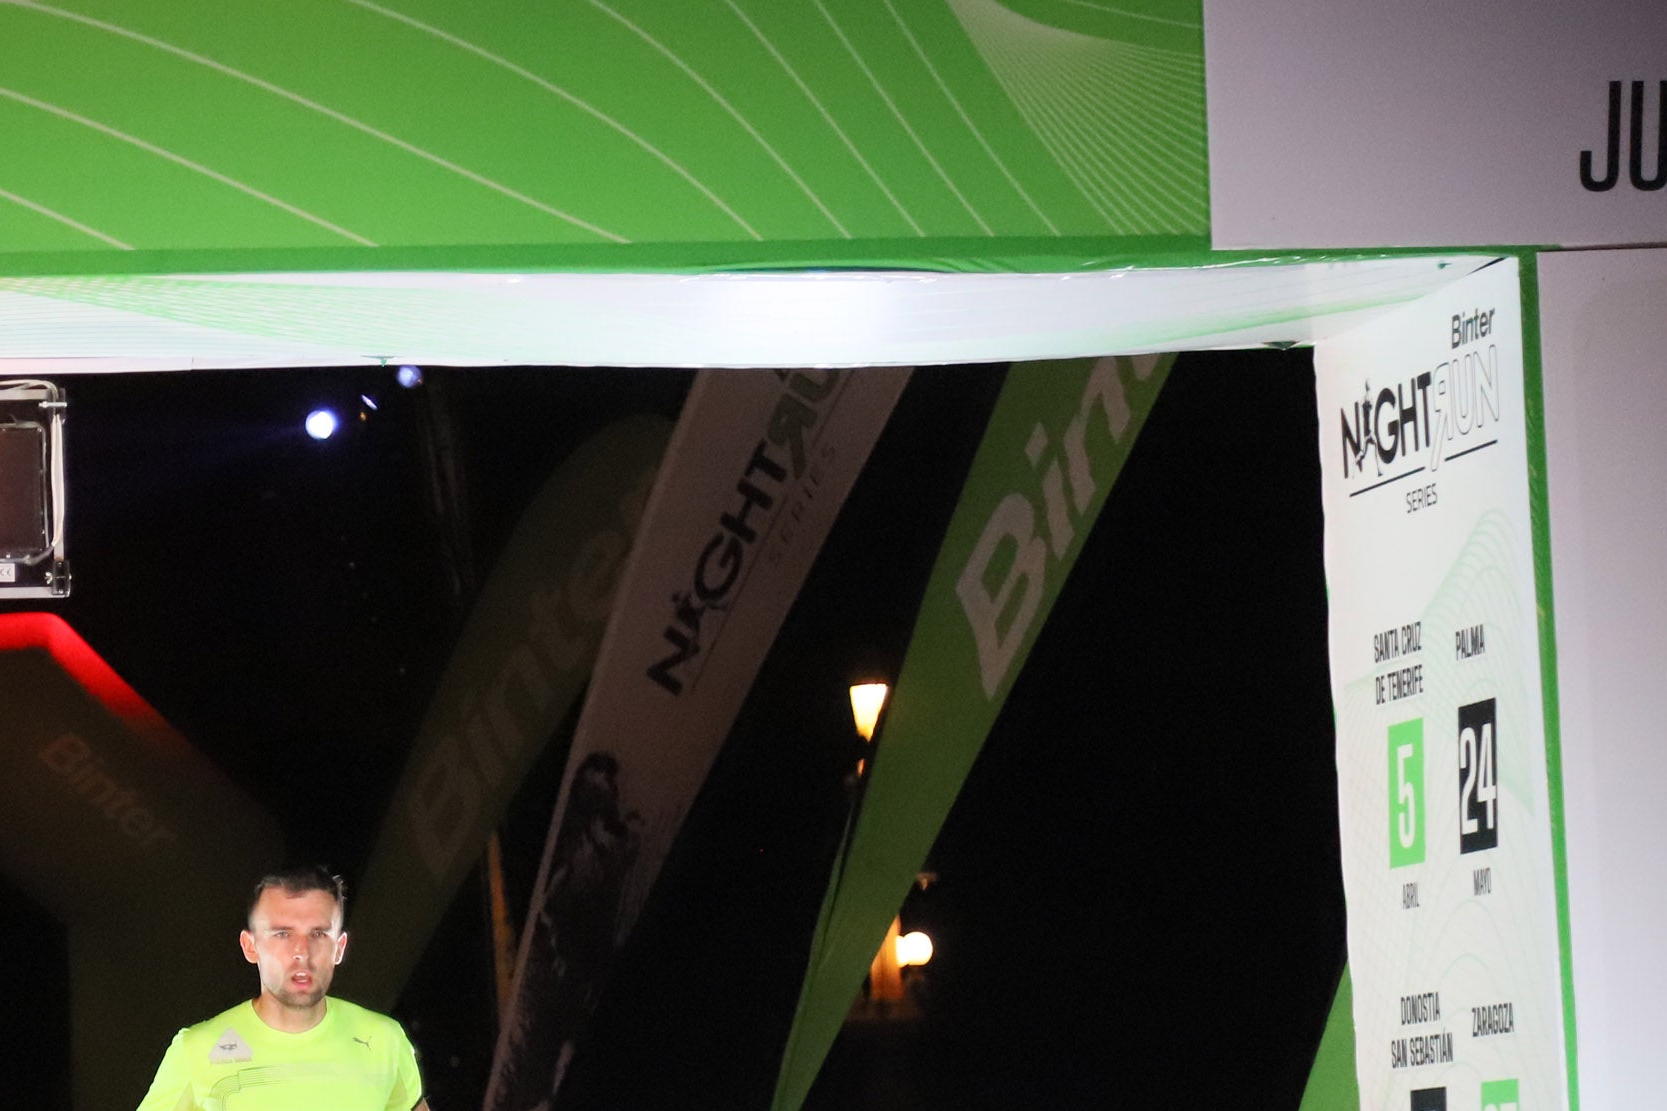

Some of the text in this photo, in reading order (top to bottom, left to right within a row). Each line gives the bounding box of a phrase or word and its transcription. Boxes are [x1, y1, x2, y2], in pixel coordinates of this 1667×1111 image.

[1451, 308, 1496, 349] Binter
[1405, 483, 1438, 514] SERIES
[956, 353, 1161, 701] Bin
[1373, 621, 1422, 663] SANTA CRUZ
[1454, 624, 1485, 661] PALMA
[1375, 664, 1424, 705] DE TENERIFE
[1396, 743, 1415, 849] 5
[1459, 722, 1497, 836] 24
[1473, 867, 1492, 896] MAYO
[1400, 992, 1441, 1026] DONOSTIA
[1471, 1002, 1515, 1038] ZARAGOZA
[1391, 1039, 1408, 1069] SAN
